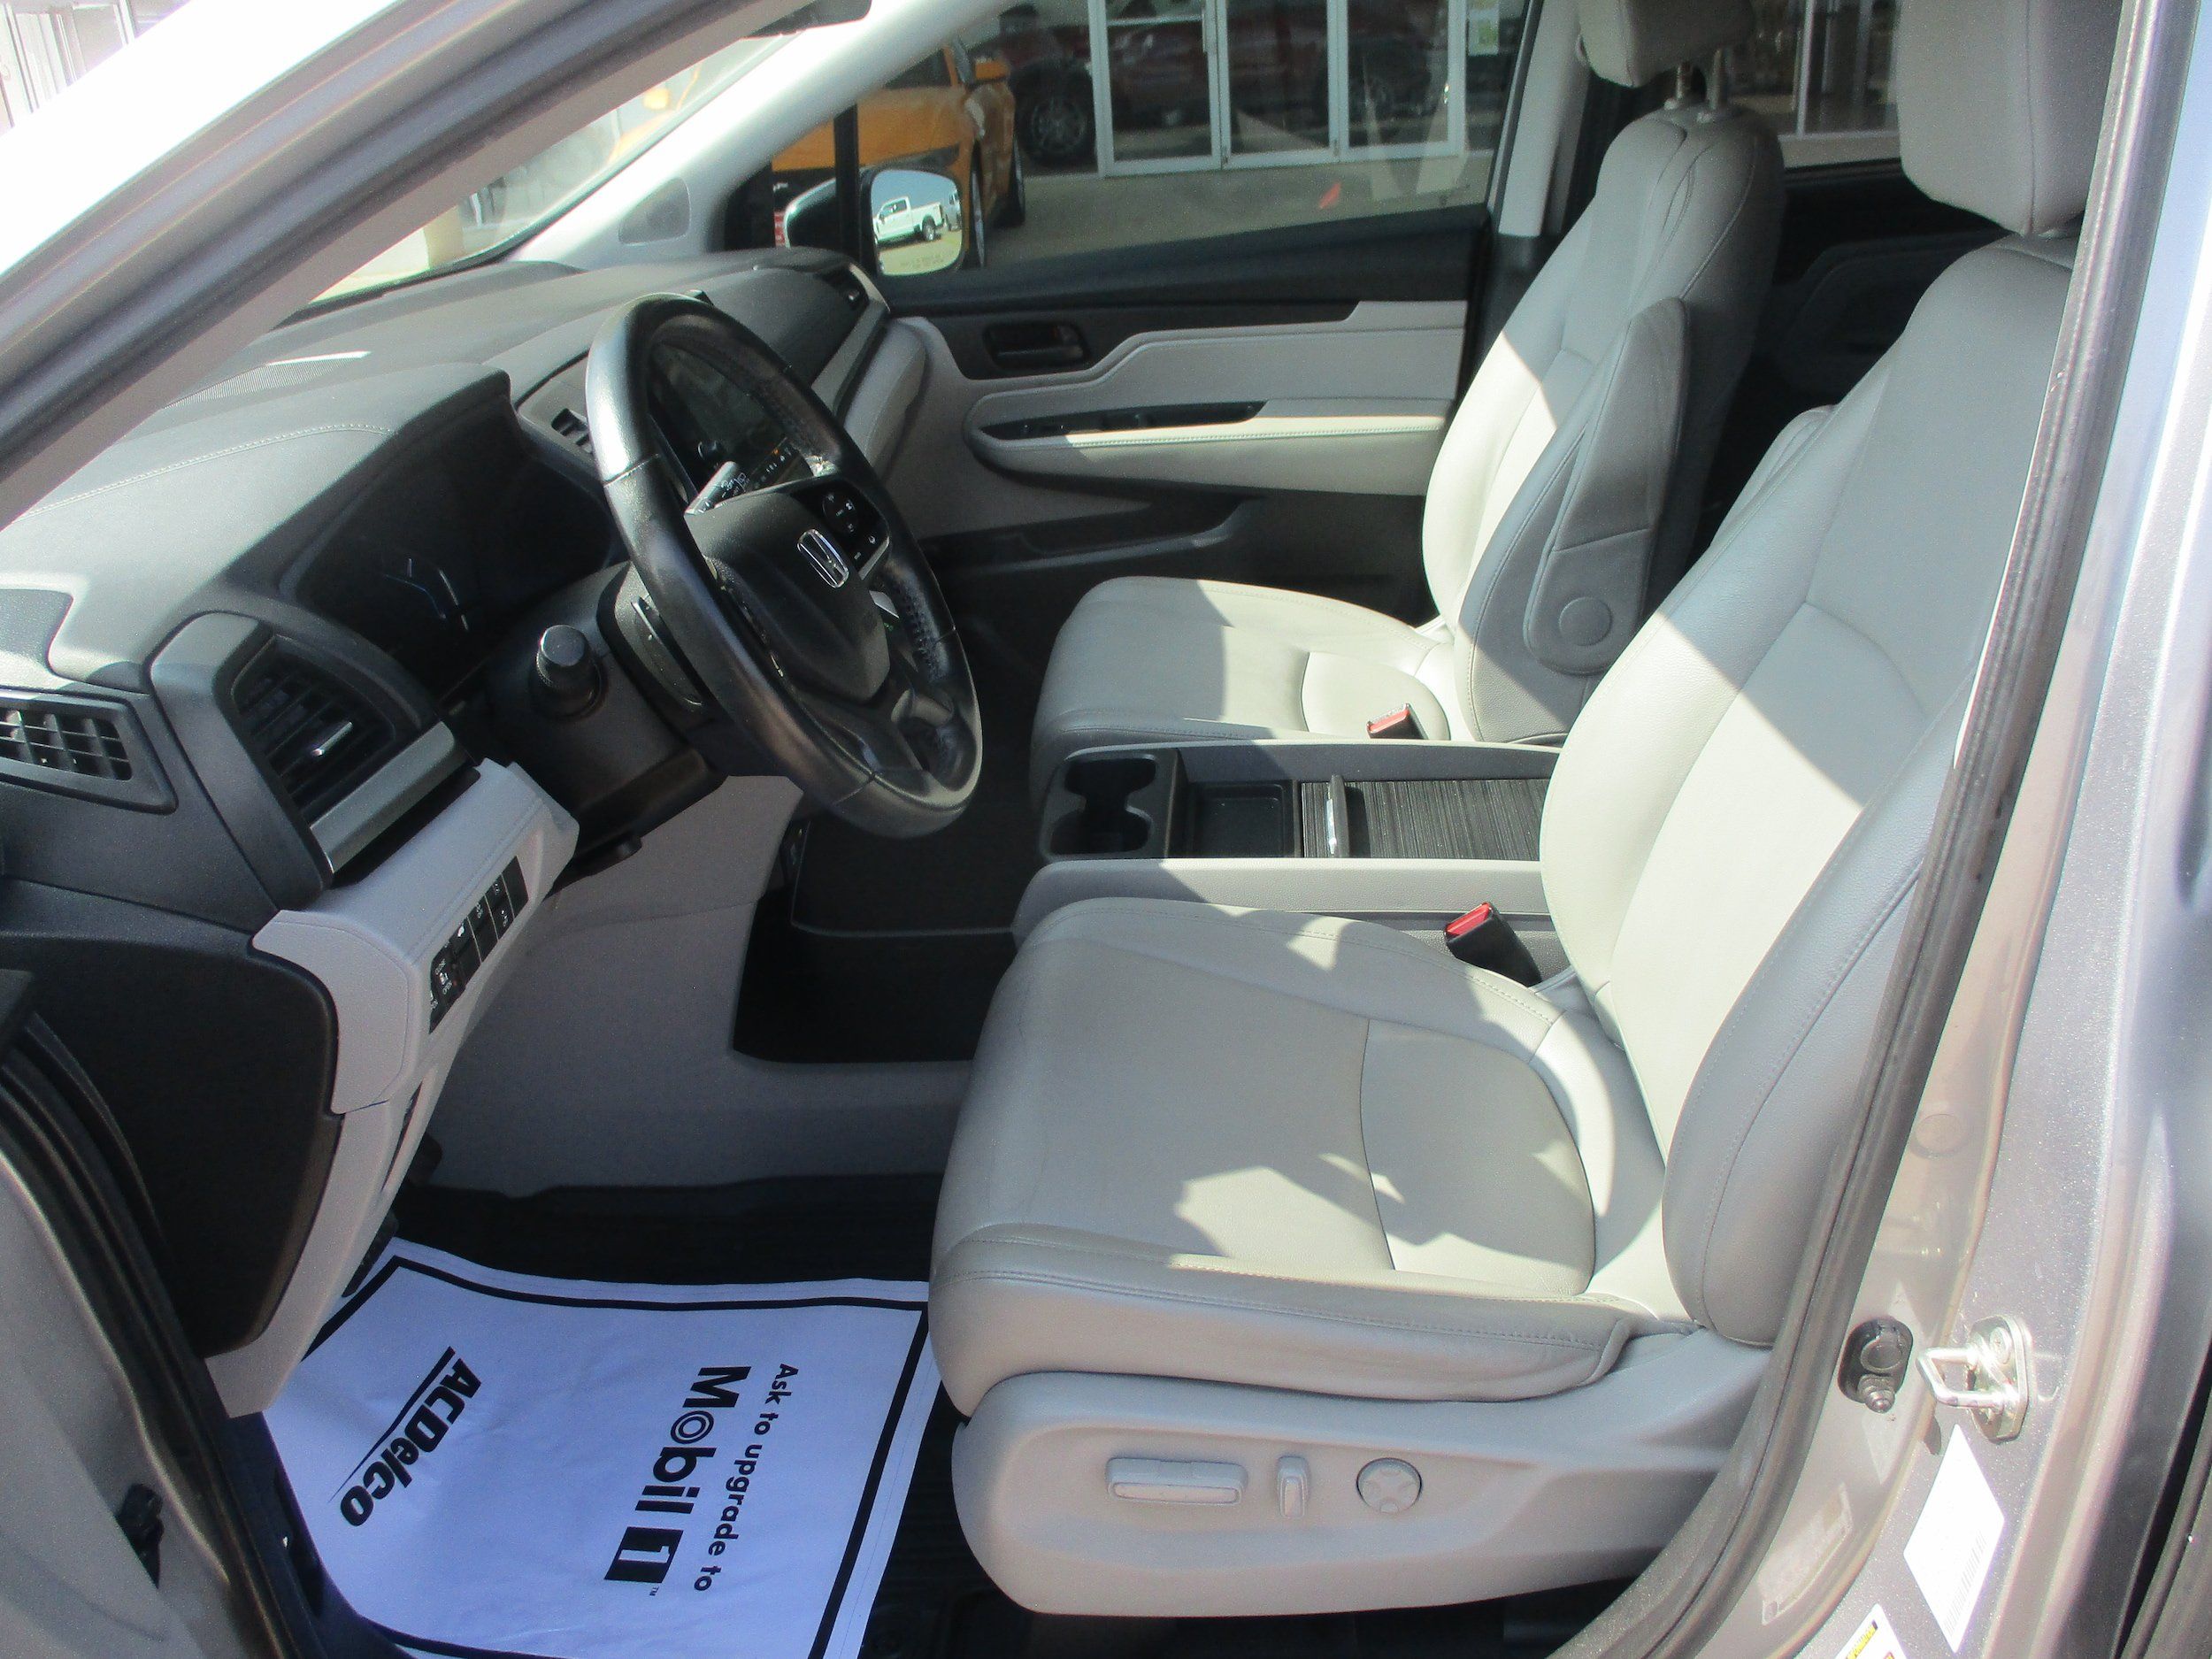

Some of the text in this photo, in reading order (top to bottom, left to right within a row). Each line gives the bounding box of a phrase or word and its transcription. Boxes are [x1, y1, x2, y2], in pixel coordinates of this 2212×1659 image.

[341, 1357, 481, 1526] ACDelco
[635, 1366, 751, 1514] Mobil
[694, 1363, 799, 1591] Ask to upgrade to
